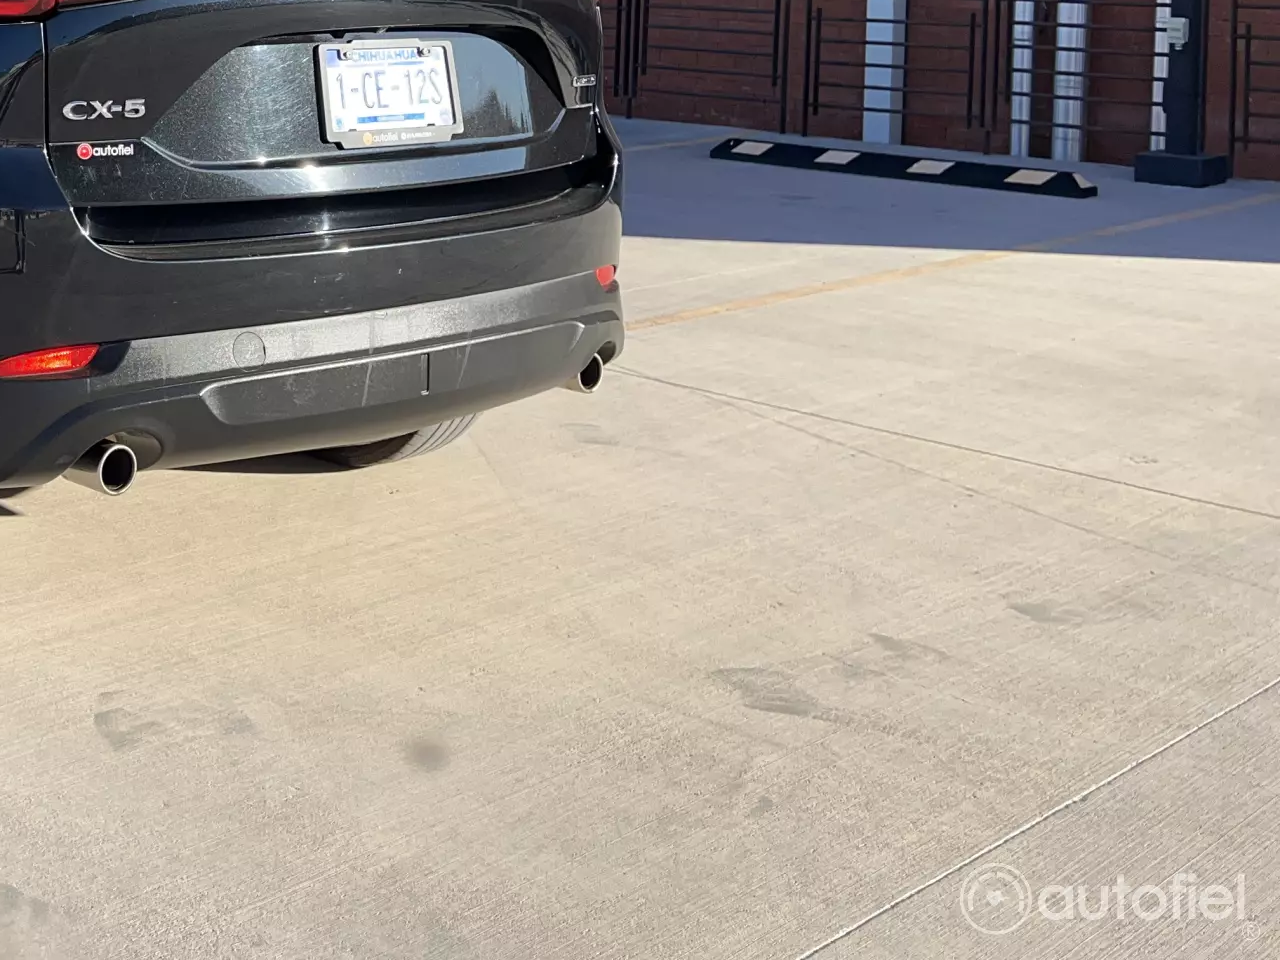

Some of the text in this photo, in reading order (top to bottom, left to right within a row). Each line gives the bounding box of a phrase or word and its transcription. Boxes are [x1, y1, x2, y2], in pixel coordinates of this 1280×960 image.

[336, 68, 443, 110] 1-CE-12S
[62, 98, 146, 120] CX-5
[93, 143, 134, 157] autofiel
